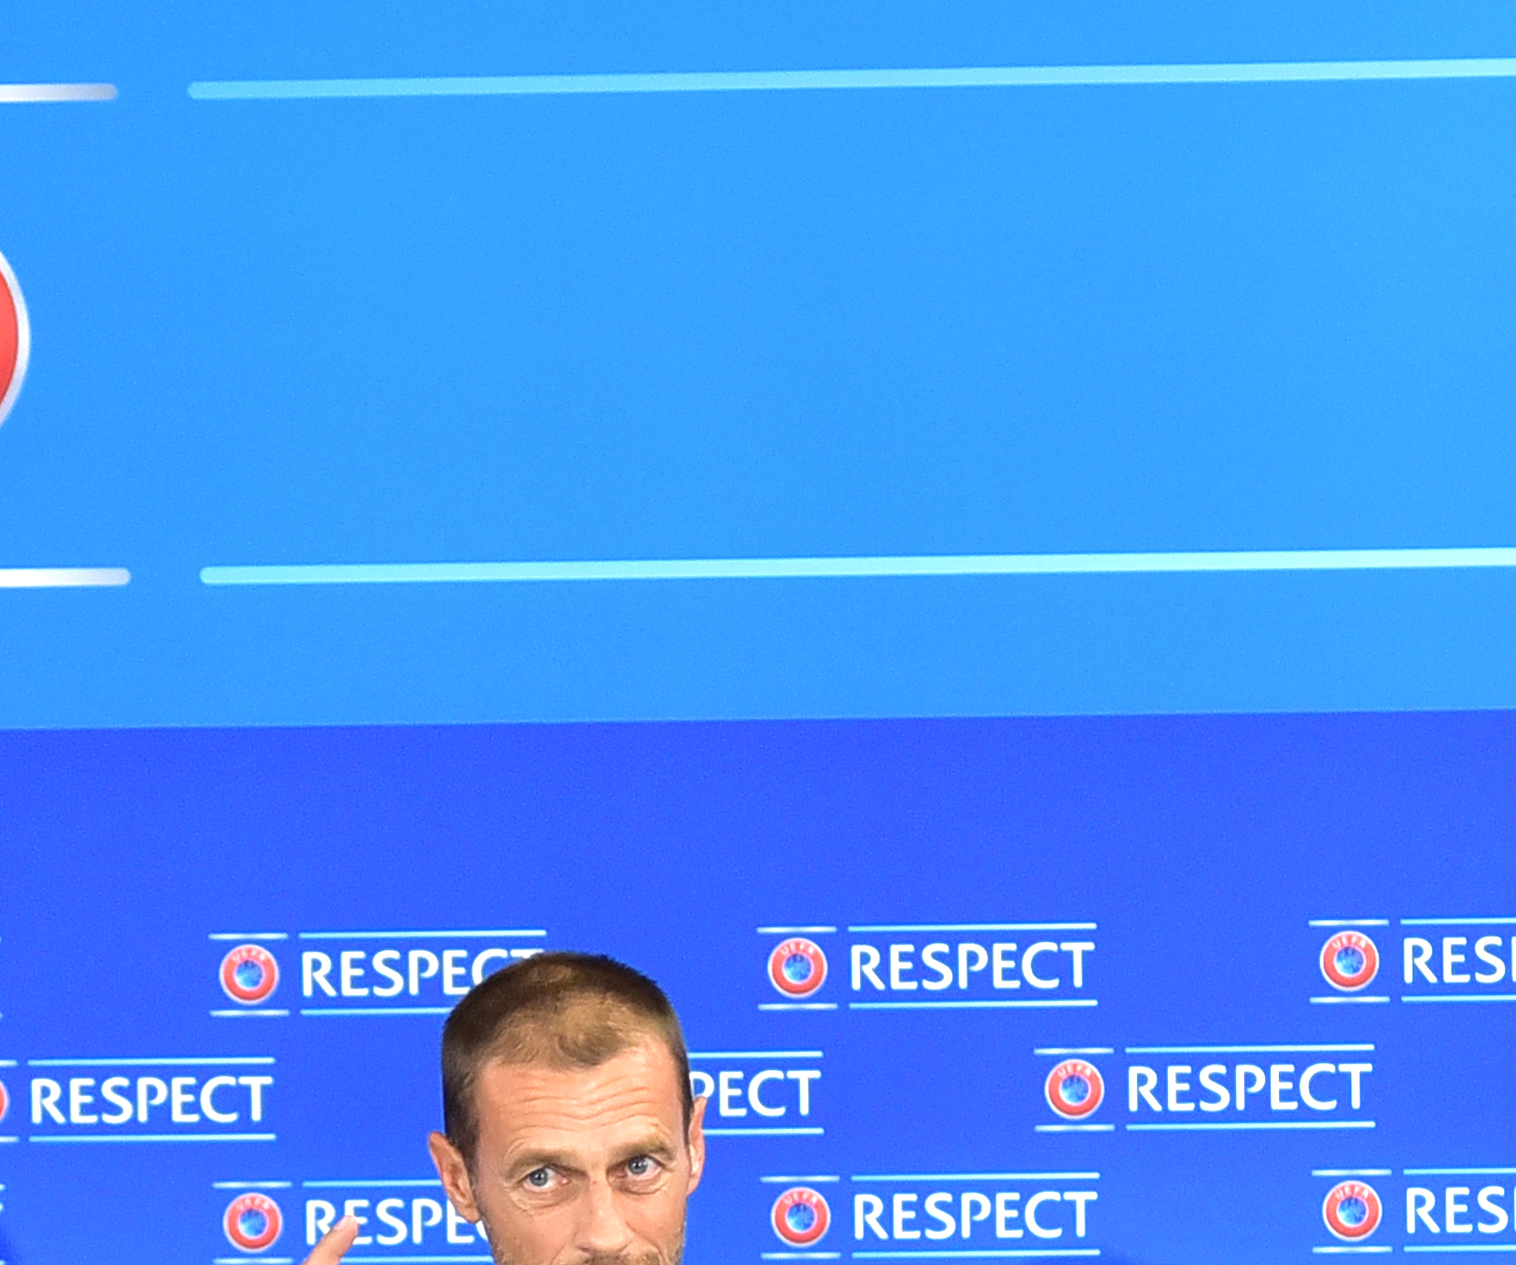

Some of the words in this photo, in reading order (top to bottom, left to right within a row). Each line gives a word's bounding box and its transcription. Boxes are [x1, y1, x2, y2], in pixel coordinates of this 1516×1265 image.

[851, 942, 1095, 990] RESPECT
[32, 1076, 273, 1124] RESPECT
[689, 1070, 821, 1116] PECT
[1129, 1063, 1372, 1111] RESPECT
[854, 1191, 1097, 1239] RESPECT
